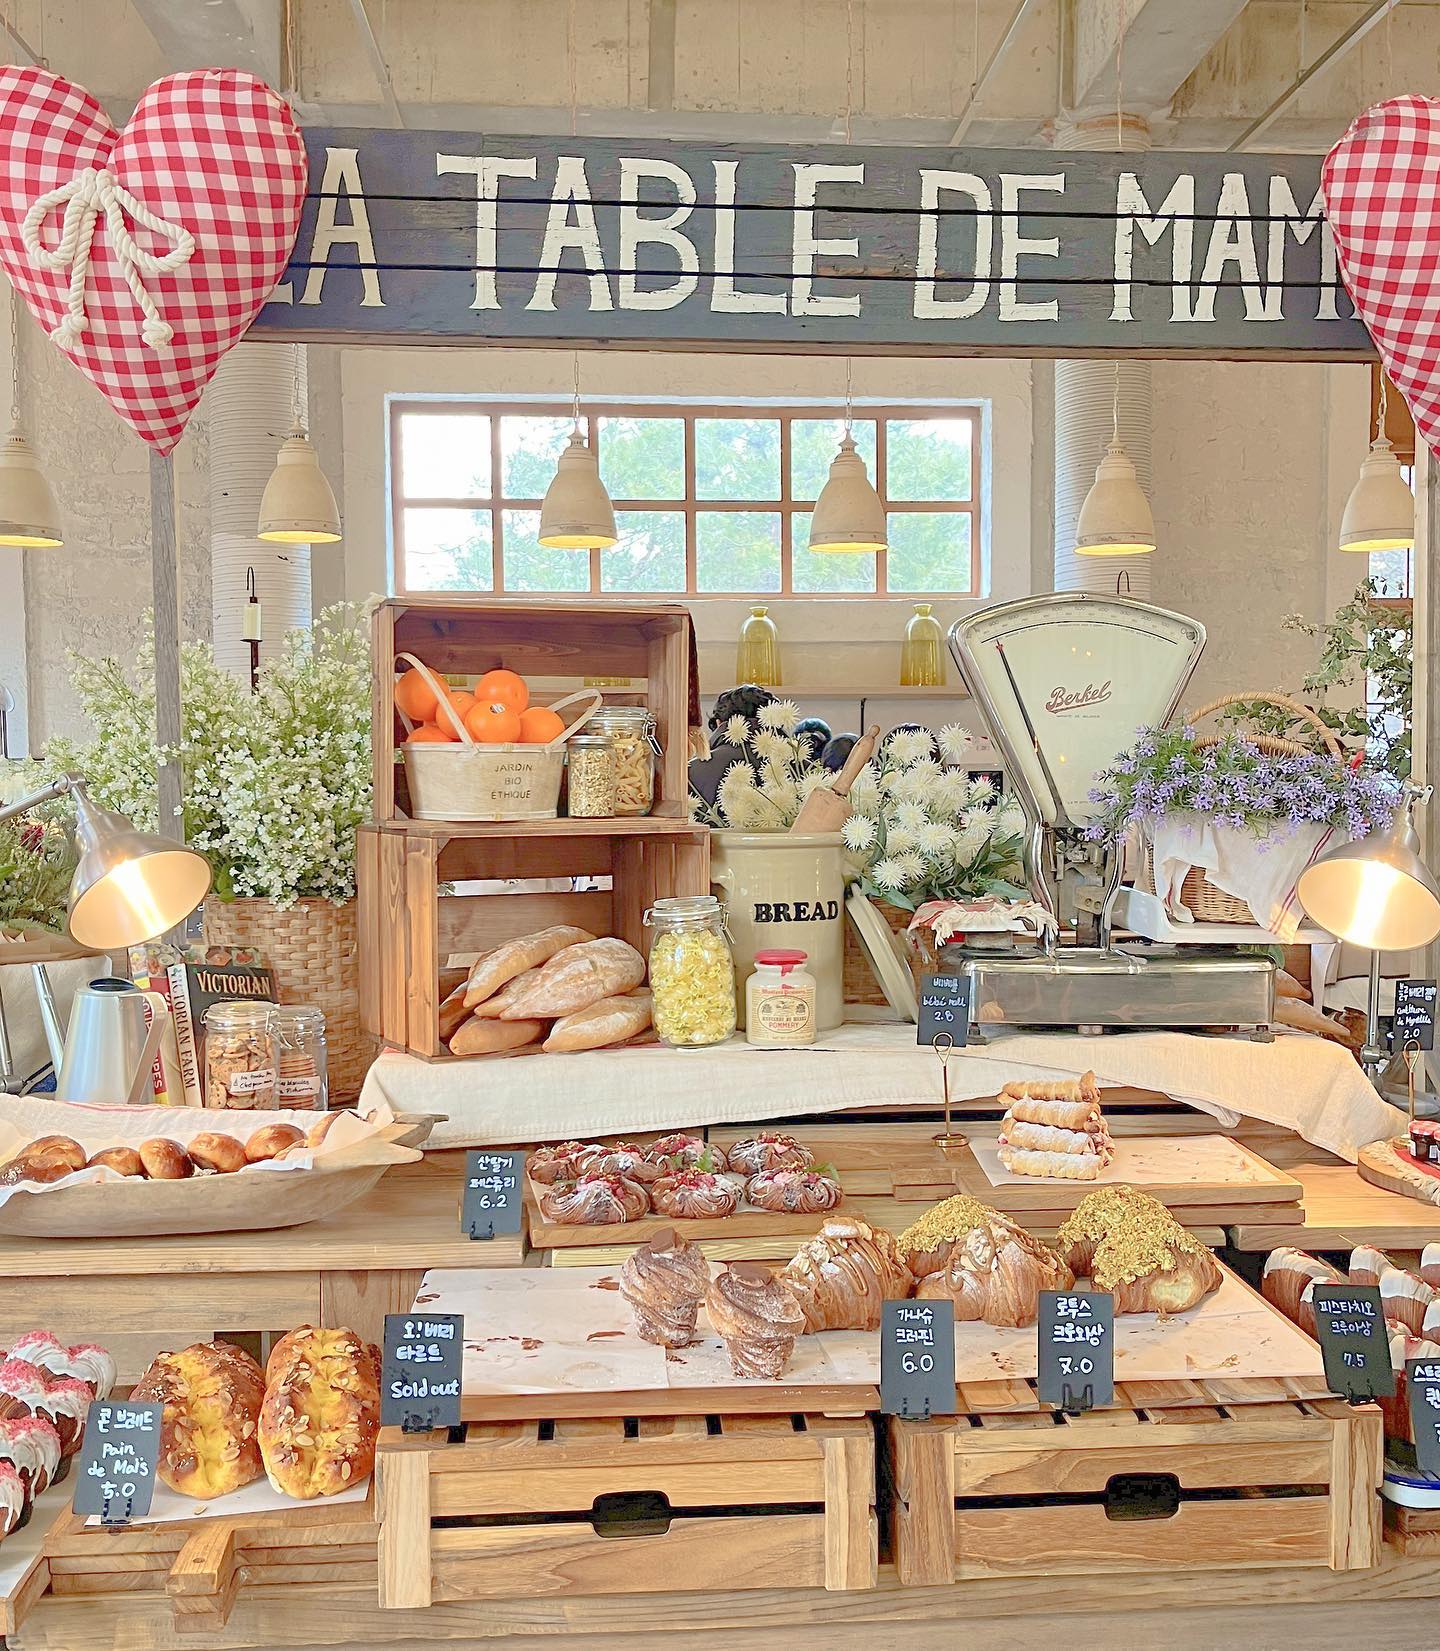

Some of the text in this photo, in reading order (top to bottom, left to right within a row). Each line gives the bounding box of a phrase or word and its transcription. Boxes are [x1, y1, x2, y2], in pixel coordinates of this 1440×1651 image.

[266, 147, 1363, 322] A TABLE DE MAM
[1046, 680, 1112, 713] Berkel
[494, 763, 533, 773] JARDIN
[504, 776, 522, 786] BIO
[754, 900, 839, 923] BREAD
[197, 970, 271, 995] VICTORIAN
[934, 1010, 954, 1022] 2.8
[1403, 1028, 1420, 1039] 2.0
[181, 1050, 196, 1089] FARM
[478, 1155, 513, 1173] 산딸기
[480, 1194, 507, 1209] 6.2
[897, 1307, 934, 1325] 가나슈
[1056, 1297, 1092, 1319] 로투스
[1319, 1299, 1377, 1316] 피스타치오
[896, 1328, 935, 1346] 크러핀
[1052, 1322, 1105, 1347] 크로와상
[1331, 1320, 1373, 1337] 크루아상
[396, 1343, 444, 1362] 타르트
[1343, 1352, 1365, 1367] 7.5
[902, 1352, 934, 1374] 6.0
[1058, 1356, 1094, 1375] 7.0
[390, 1377, 460, 1399] Sold out
[98, 1407, 153, 1433] 콘 브레드
[102, 1441, 135, 1459] Pain
[87, 1460, 106, 1477] de
[100, 1480, 136, 1499] 5.0
